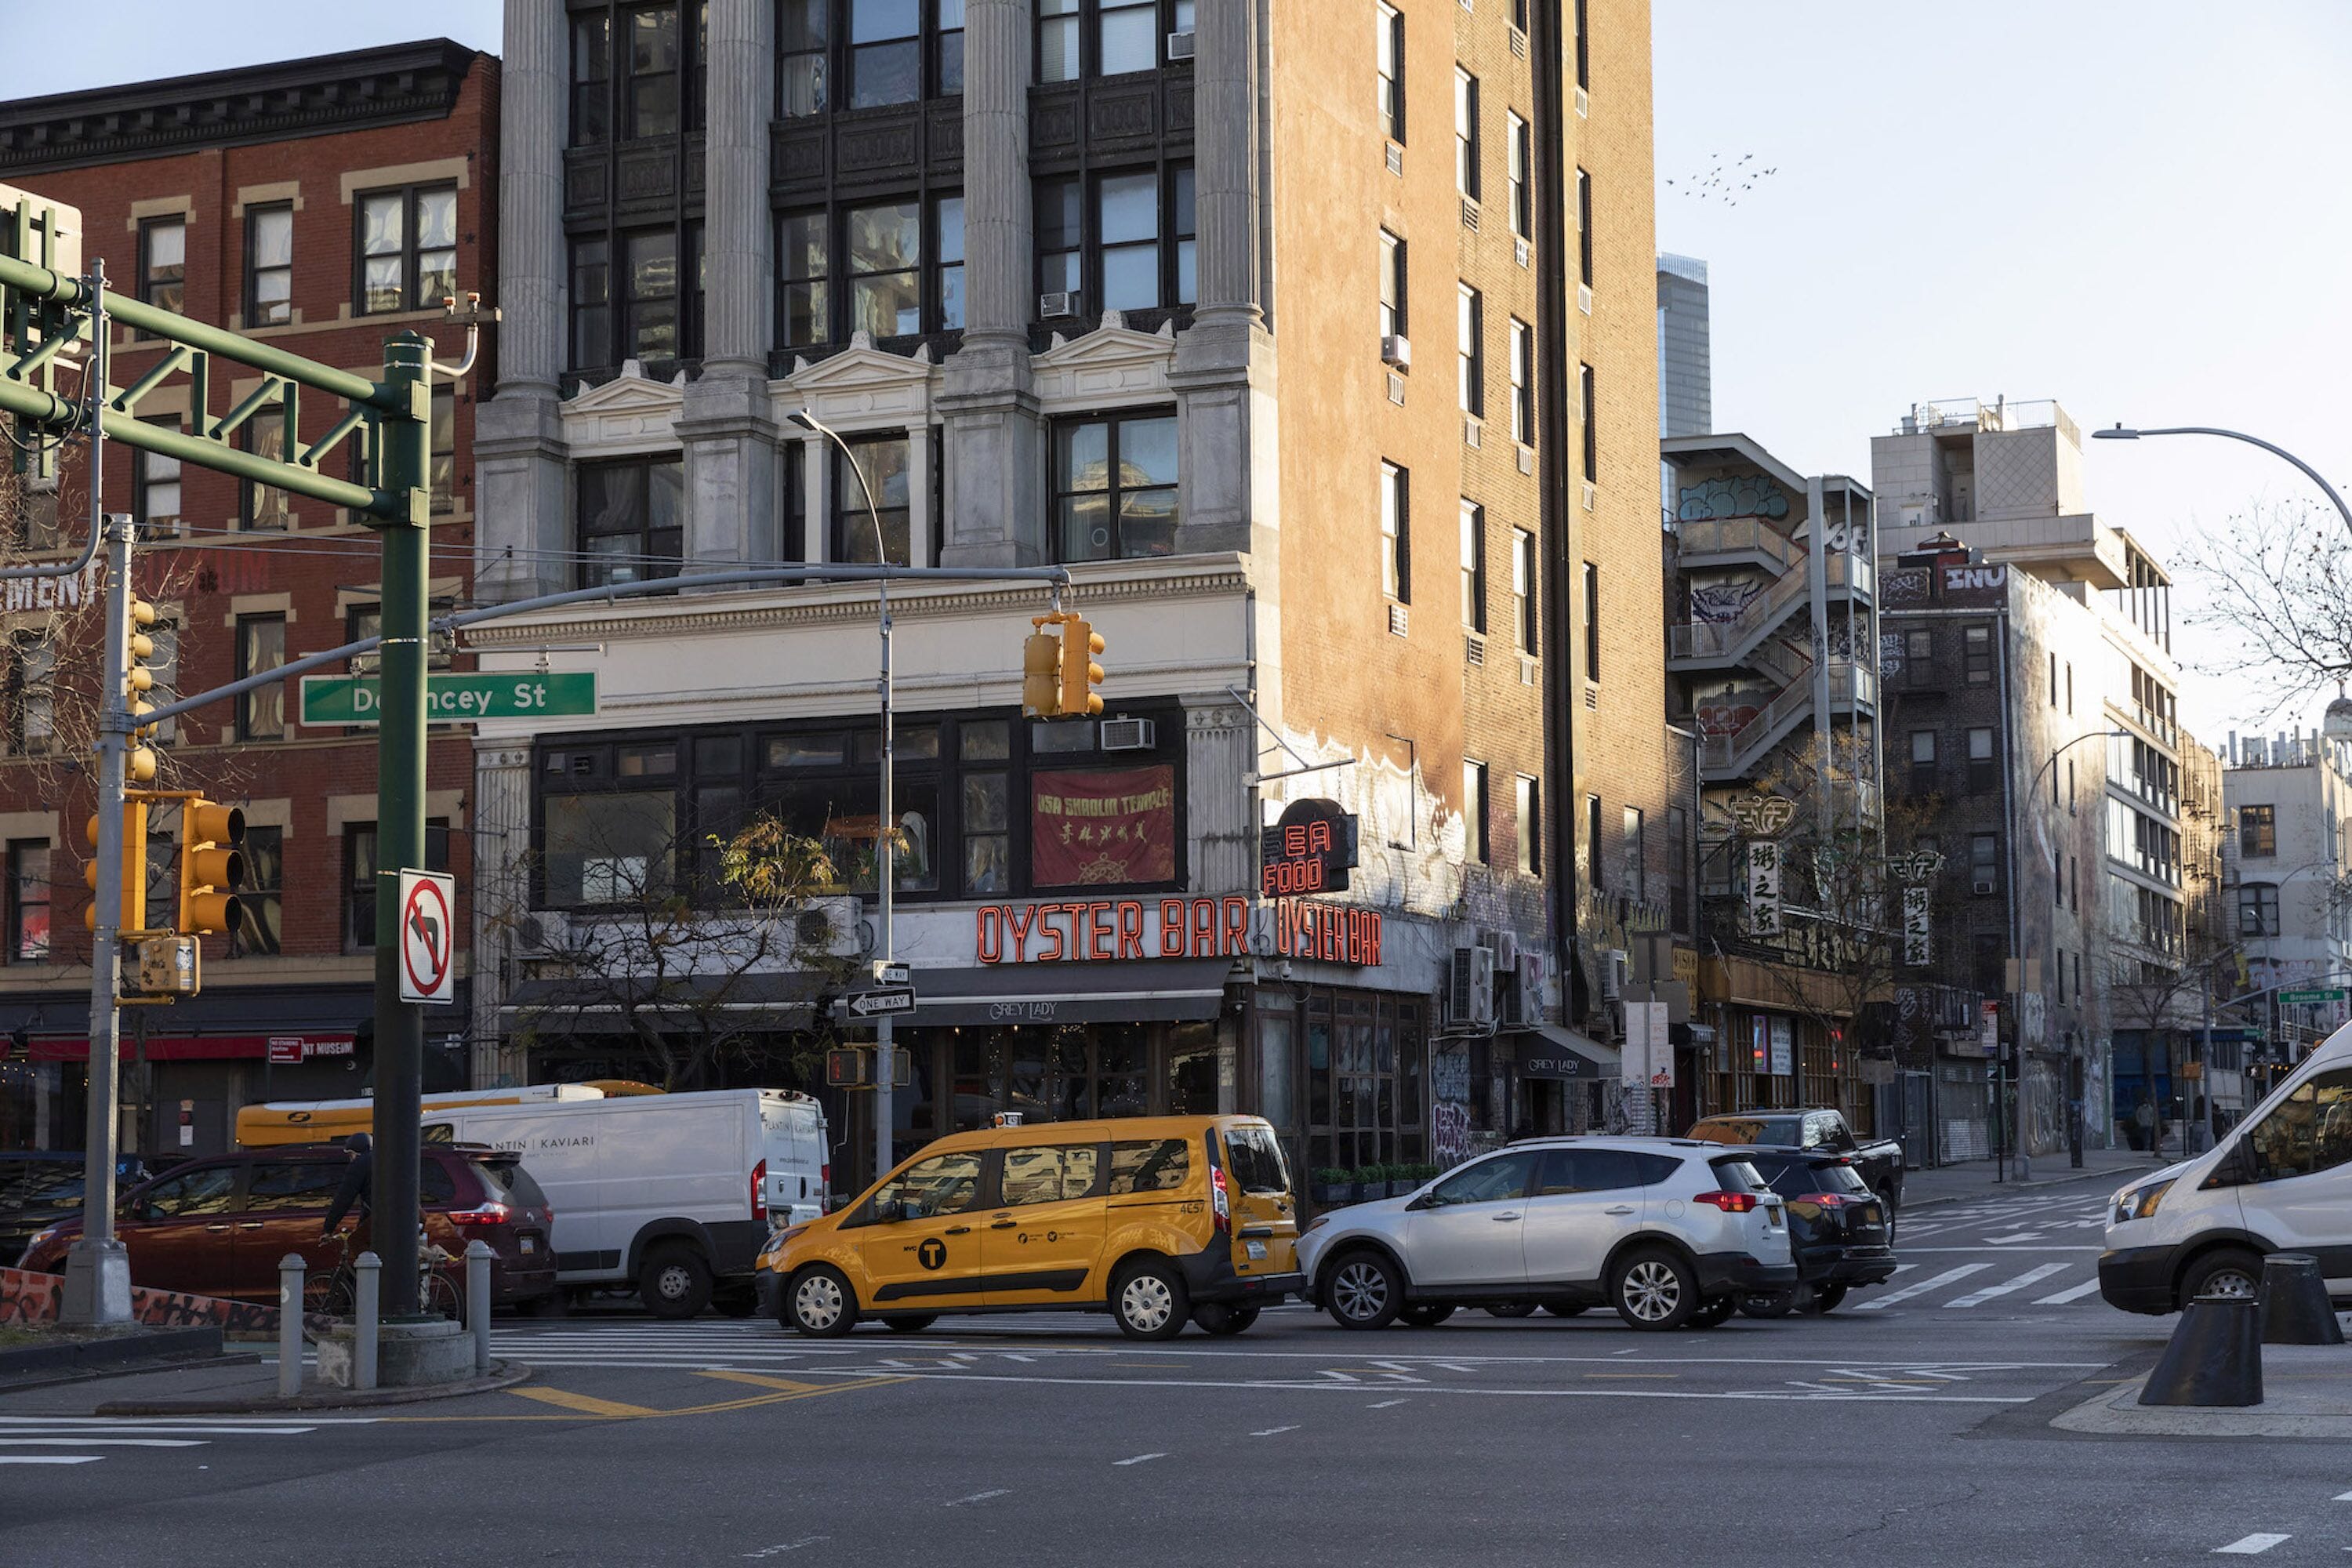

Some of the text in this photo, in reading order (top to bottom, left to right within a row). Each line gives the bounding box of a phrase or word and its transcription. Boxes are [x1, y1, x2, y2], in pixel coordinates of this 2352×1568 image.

[0, 558, 103, 612] MENT
[514, 683, 546, 708] St
[1037, 787, 1169, 817] USA SHAOLIN TEMPLE
[1264, 820, 1330, 857] SEA
[1263, 858, 1322, 895] FOOD
[1749, 845, 1777, 931] 粥之家
[978, 896, 1248, 963] OYSTER BAR
[1278, 898, 1382, 966] OYSTER BAR
[895, 969, 906, 978] WAY
[859, 996, 905, 1010] ONE WAY
[2289, 992, 2321, 1001] Broome
[989, 1002, 1058, 1021] GREY LADY
[316, 1041, 353, 1055] MUSEUM
[1528, 1058, 1581, 1075] GREY LADY
[541, 1136, 593, 1149] KAVIARI
